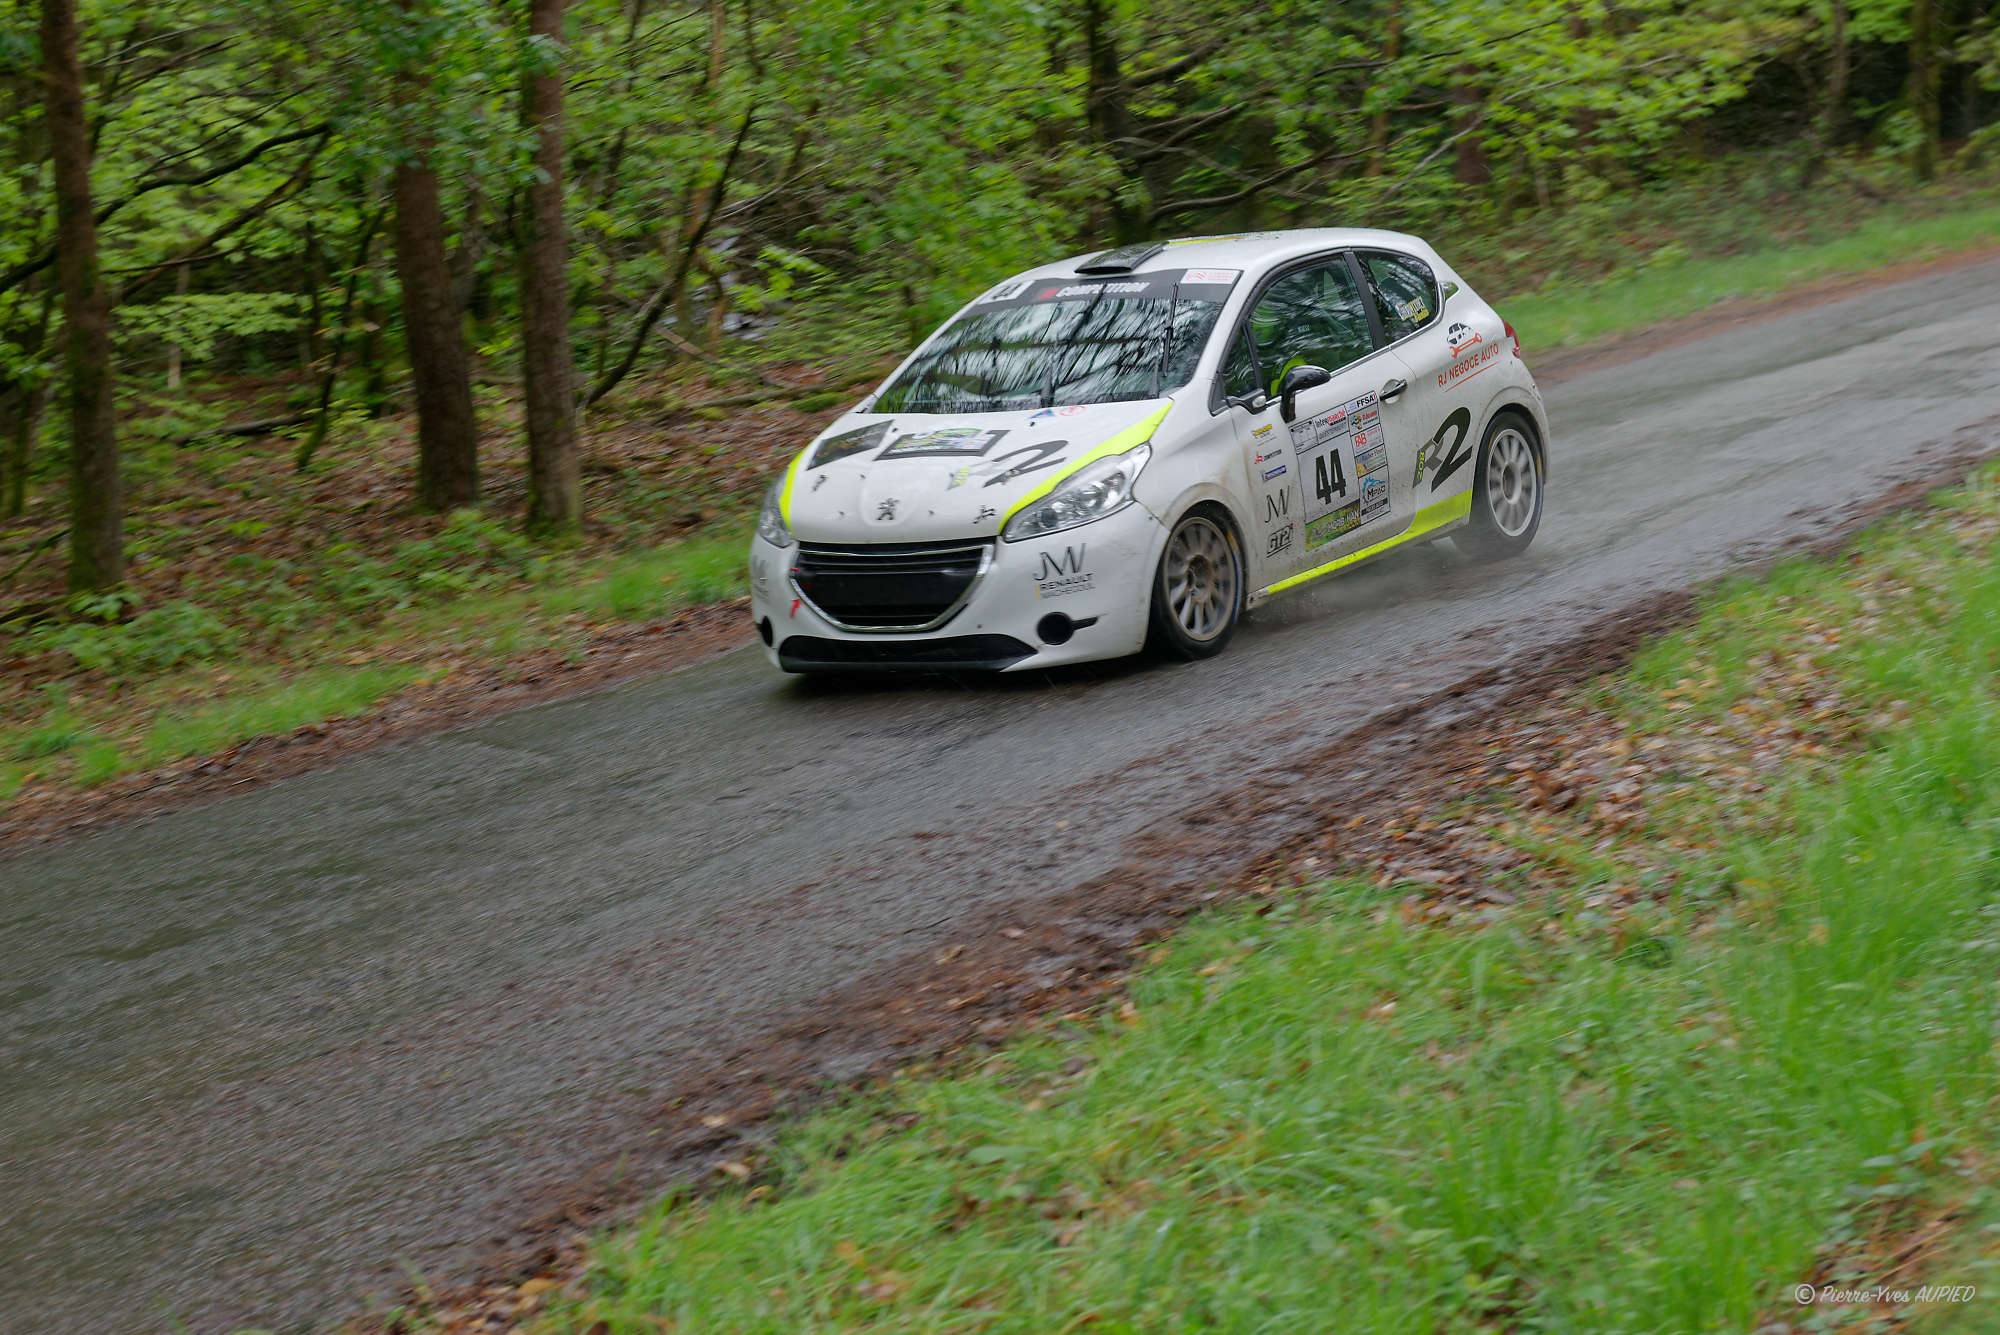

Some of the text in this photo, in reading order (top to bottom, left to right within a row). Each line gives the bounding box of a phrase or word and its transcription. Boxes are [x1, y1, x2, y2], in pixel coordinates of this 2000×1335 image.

[1438, 343, 1499, 387] RJ NEGOCE AUTO
[1356, 394, 1375, 408] FFSA
[1315, 448, 1347, 505] 44
[1040, 573, 1094, 591] RENAULT
